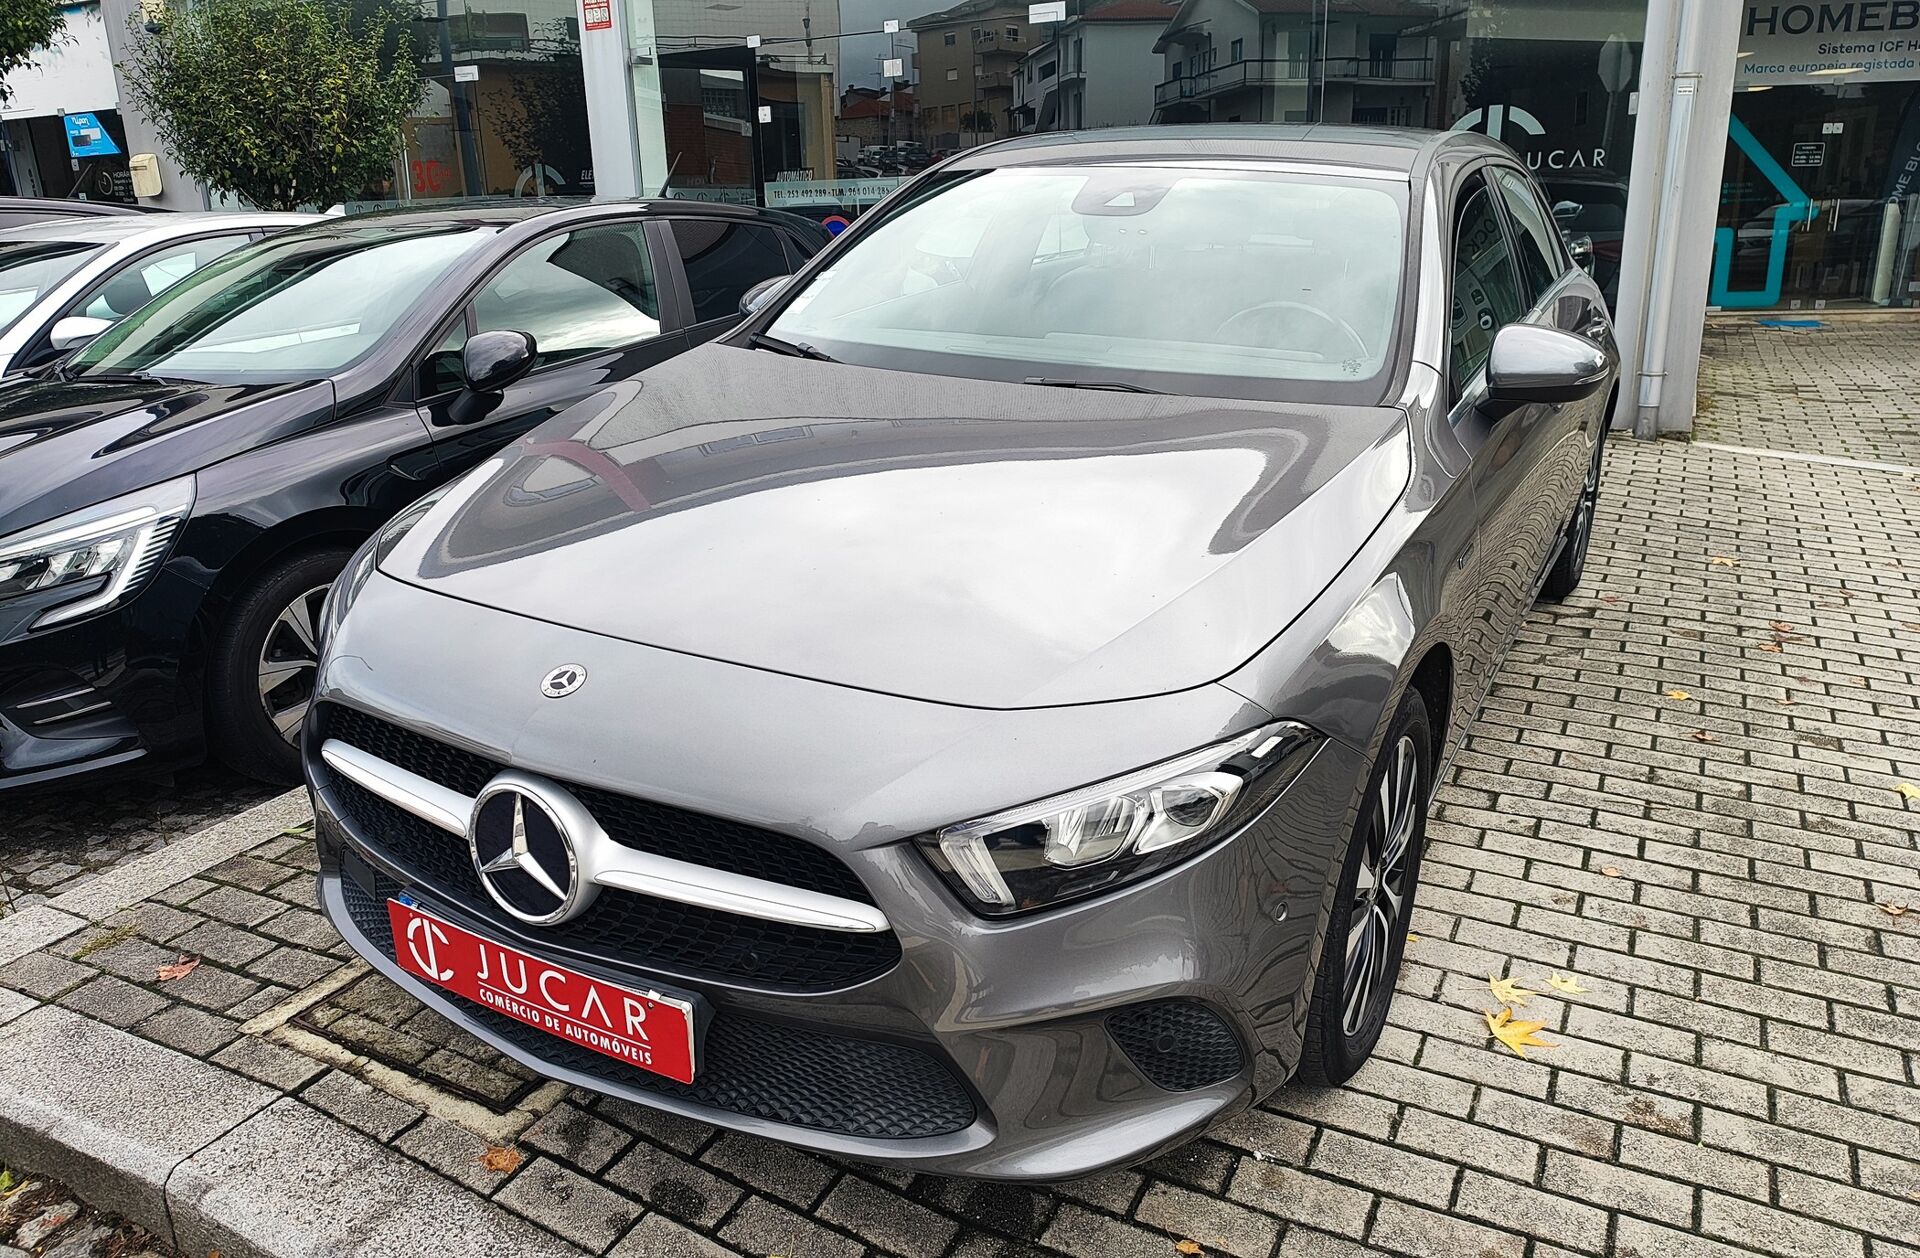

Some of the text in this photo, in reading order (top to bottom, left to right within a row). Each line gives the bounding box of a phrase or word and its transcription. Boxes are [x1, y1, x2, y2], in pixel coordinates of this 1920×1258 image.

[1746, 1, 1920, 36] HOMEB
[1818, 42, 1875, 55] Sistema
[1879, 41, 1904, 53] ICF
[1743, 62, 1785, 74] Marca
[1851, 57, 1915, 73] registada
[1526, 148, 1606, 170] UCAR
[776, 167, 813, 182] AUTOMÁTICO
[476, 943, 649, 1041] JUCAR
[479, 988, 652, 1065] COMÉRCIO DE AUTOMÓVEIS
